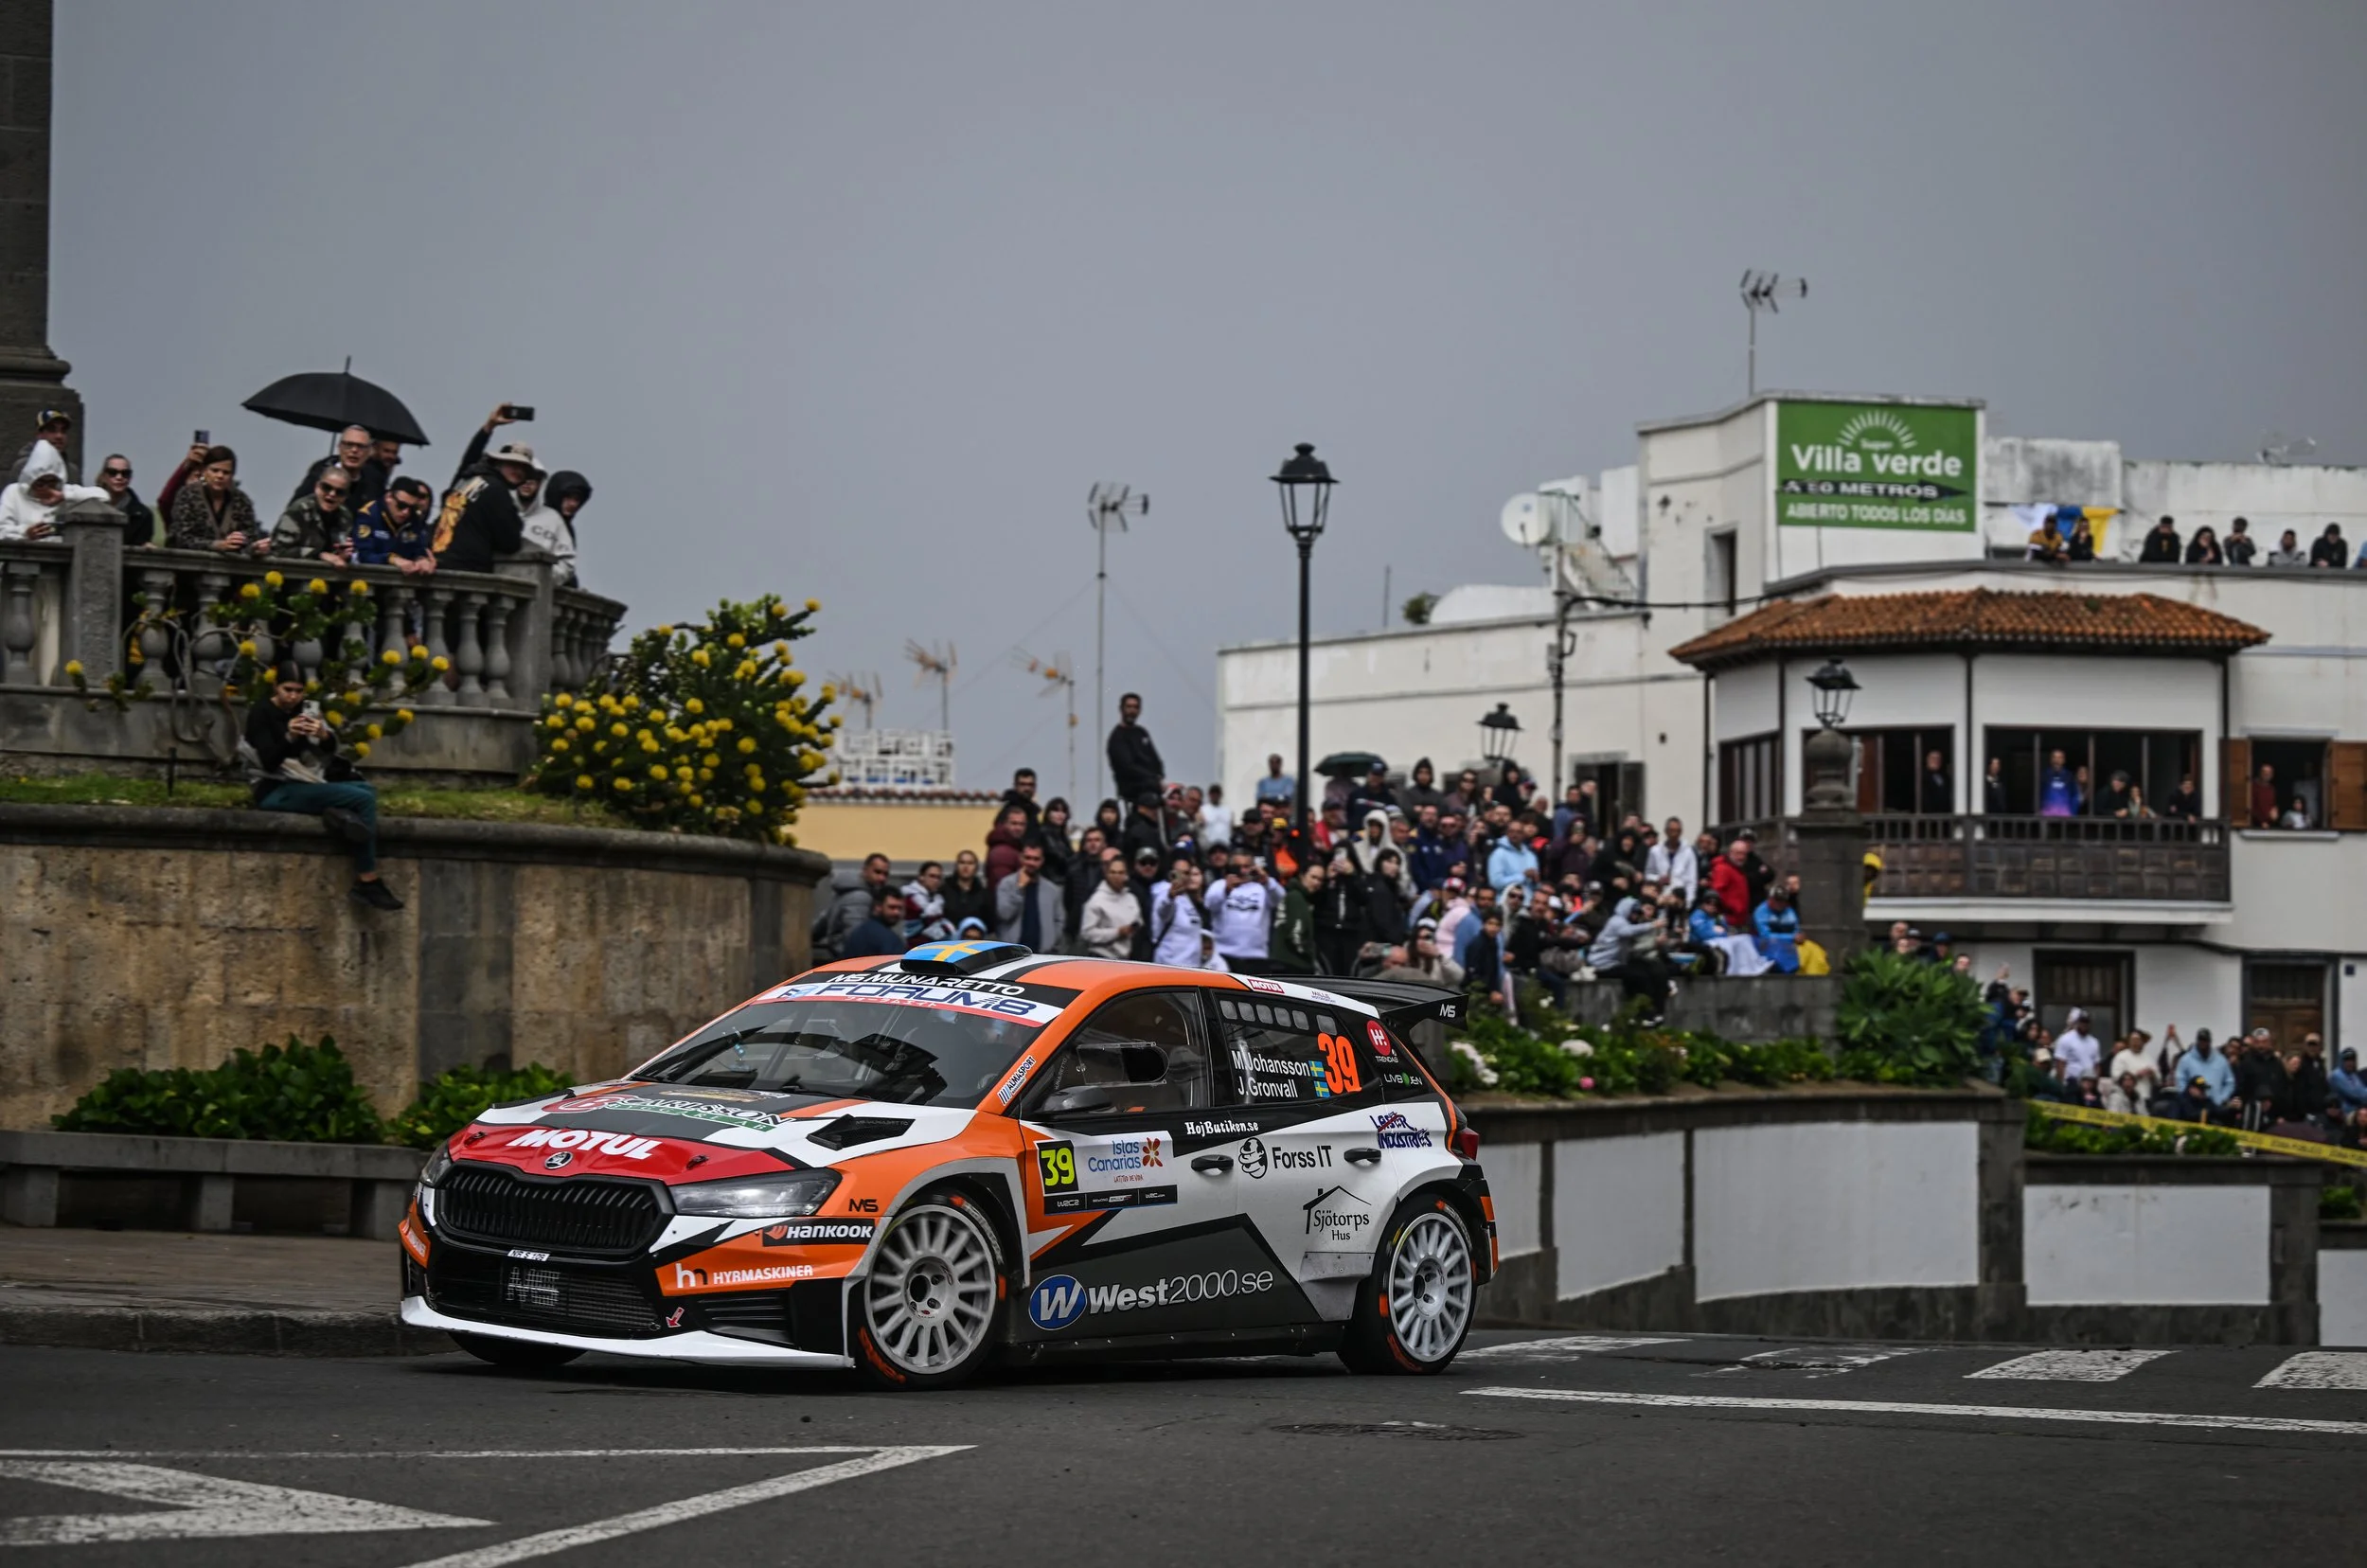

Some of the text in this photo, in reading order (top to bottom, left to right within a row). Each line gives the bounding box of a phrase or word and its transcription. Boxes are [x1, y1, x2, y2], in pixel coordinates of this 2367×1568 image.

[1790, 443, 1964, 476] Villa verde
[1784, 479, 1802, 494] A
[1839, 482, 1939, 499] METROS
[1786, 503, 1967, 525] ABIERTO TODOS LOS DÍAS
[864, 973, 1024, 995] MUNARETTO
[1250, 980, 1283, 992] MOTUL
[815, 984, 1037, 1015] FORUM8
[1439, 1004, 1456, 1018] MS
[1007, 1056, 1036, 1090] ALMASPORT
[1317, 1032, 1361, 1094] 39
[618, 1097, 796, 1126] CARLSSON
[505, 1129, 664, 1160] MOTUL
[1112, 1140, 1140, 1155] Islas
[1041, 1148, 1076, 1186] 39
[1088, 1155, 1142, 1172] Canarias
[1272, 1145, 1332, 1169] Forss IT
[848, 1198, 880, 1213] MS
[1313, 1209, 1370, 1233] Sjötorps
[1331, 1230, 1351, 1240] Hus
[713, 1265, 814, 1285] HYRMASKINER
[1088, 1269, 1274, 1315] West2000.se
